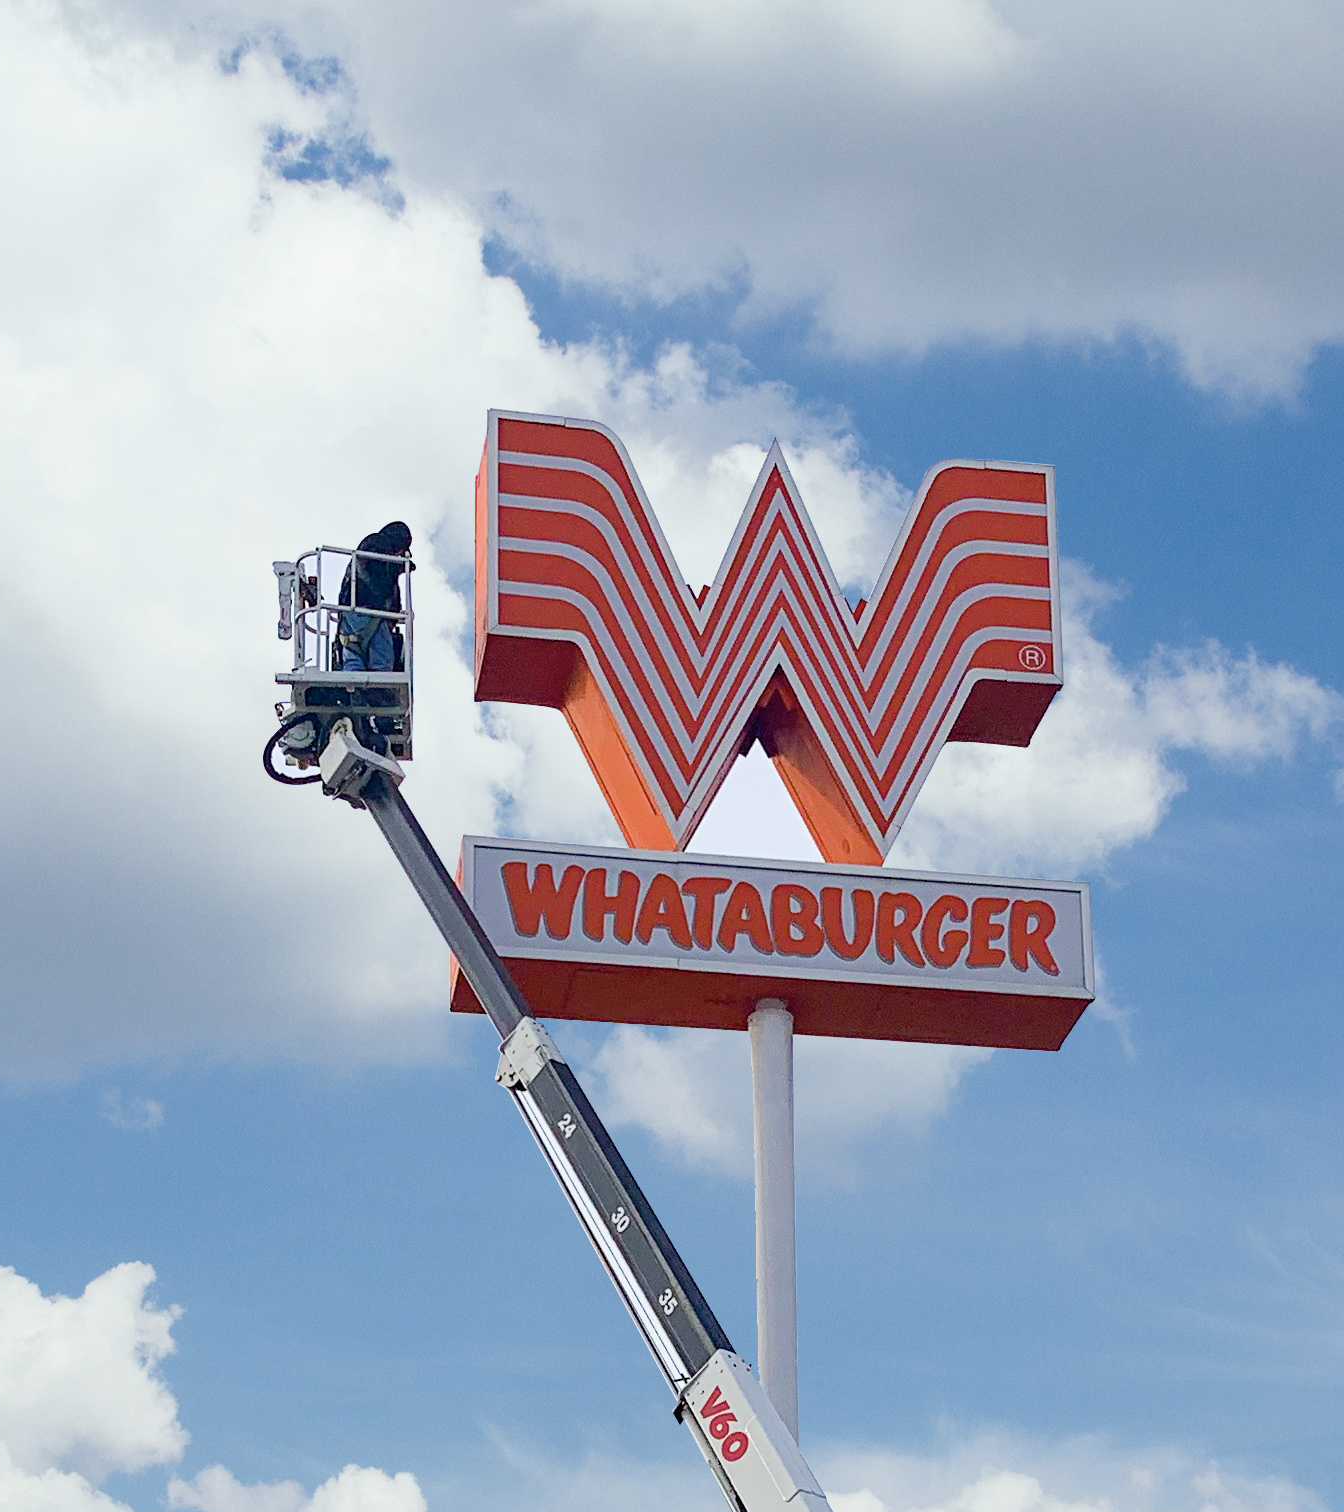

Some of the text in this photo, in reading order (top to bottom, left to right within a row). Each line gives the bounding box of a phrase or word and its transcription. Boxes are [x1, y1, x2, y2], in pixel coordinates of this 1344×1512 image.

[500, 861, 1061, 976] WHATABURGER
[557, 1112, 577, 1139] 24
[610, 1206, 630, 1233] 30
[658, 1288, 678, 1316] 35
[699, 1385, 749, 1462] V60
